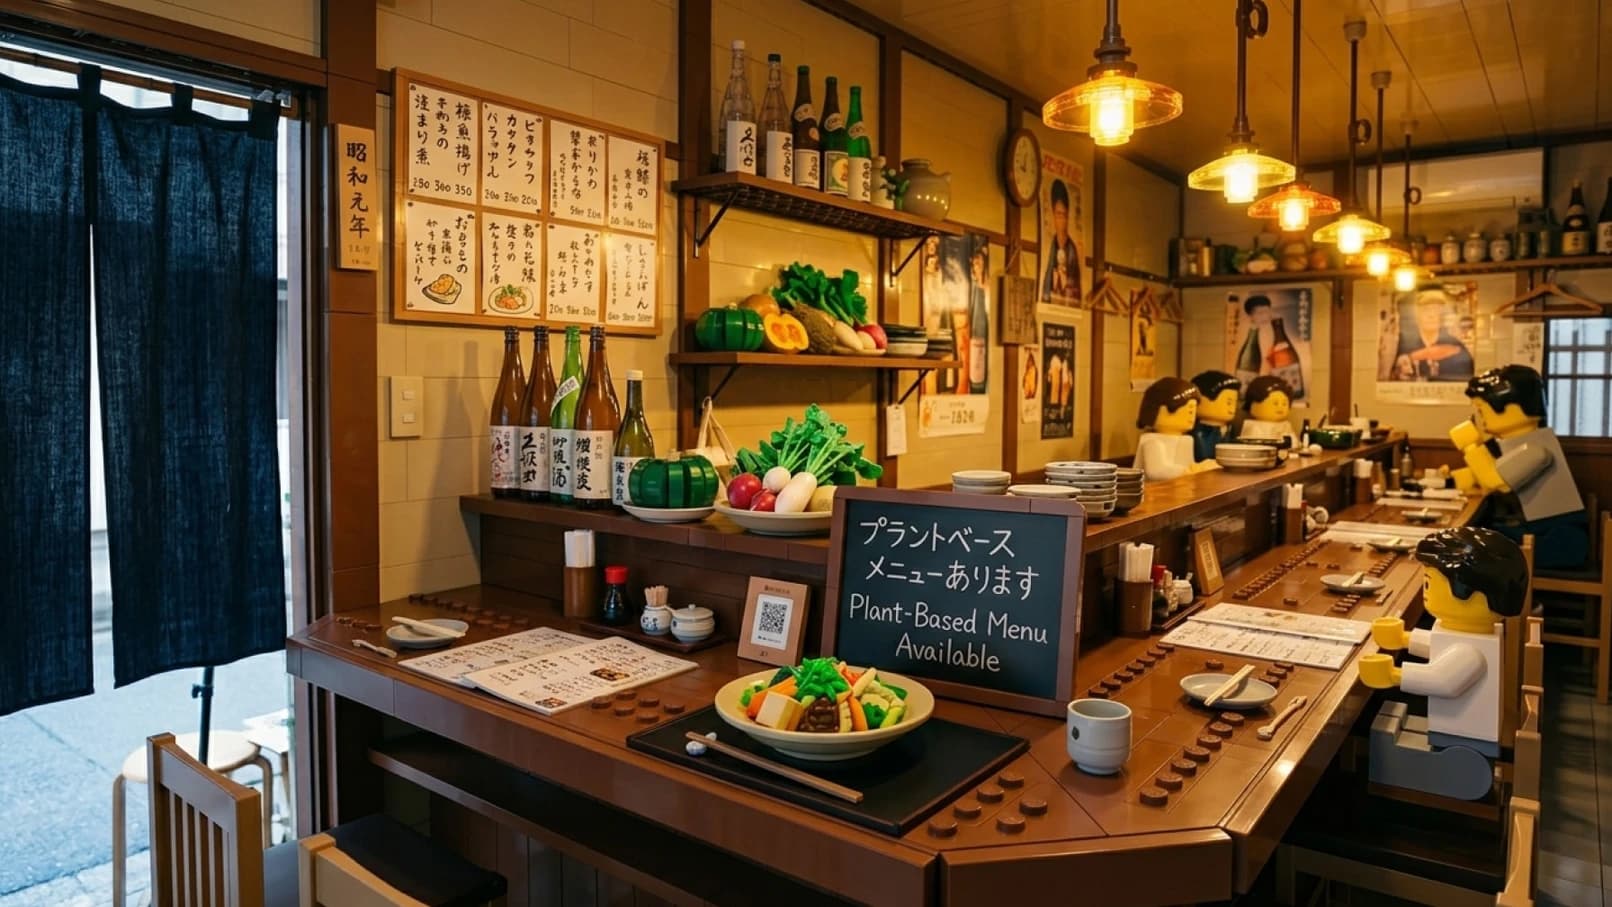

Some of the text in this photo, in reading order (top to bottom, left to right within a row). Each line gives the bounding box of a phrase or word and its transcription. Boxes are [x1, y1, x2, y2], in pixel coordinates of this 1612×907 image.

[346, 142, 371, 240] 昭和元年
[455, 184, 473, 197] 350
[859, 516, 1015, 558] プラントベース
[865, 555, 1041, 601] メニューあります
[849, 592, 1048, 644] Plant-Based Menu
[894, 632, 1001, 672] Available
